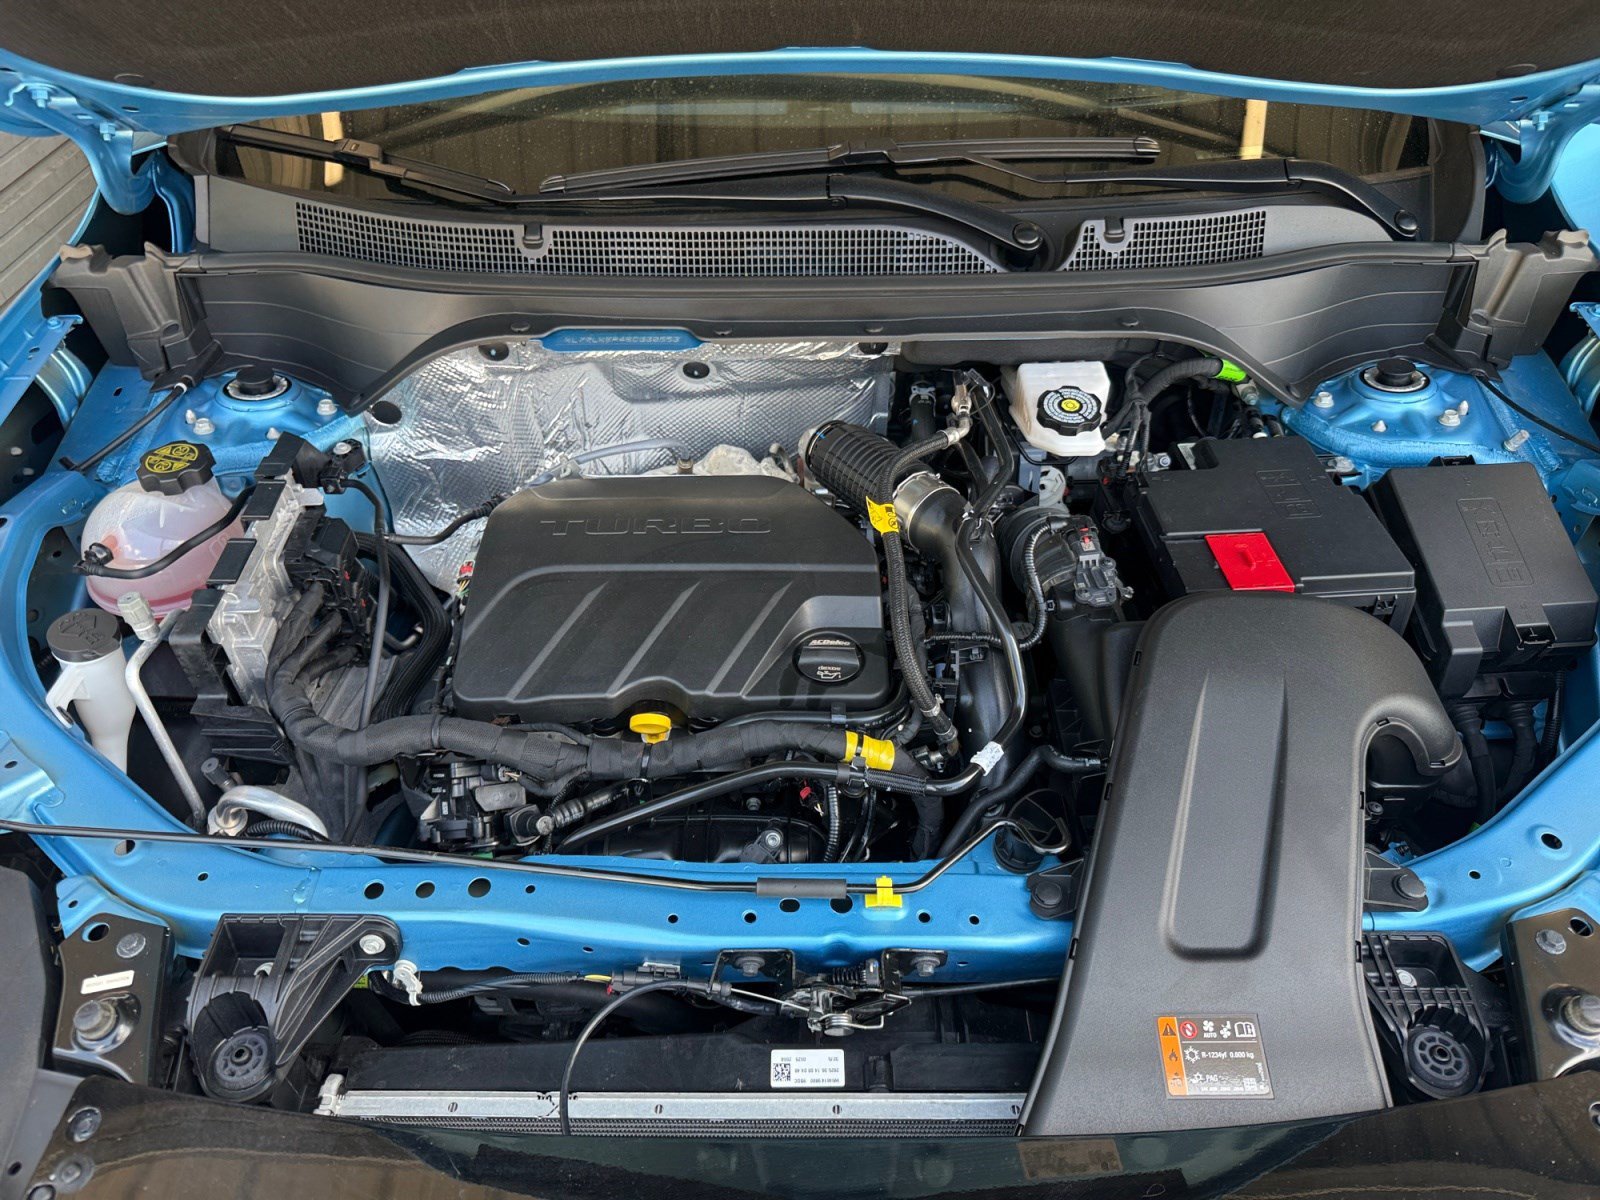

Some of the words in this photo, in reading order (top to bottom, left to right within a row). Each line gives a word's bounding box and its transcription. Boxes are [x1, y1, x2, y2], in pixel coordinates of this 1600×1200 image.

[540, 518, 771, 536] TURBO
[808, 639, 851, 647] ACDelco
[1246, 1051, 1255, 1060] kg
